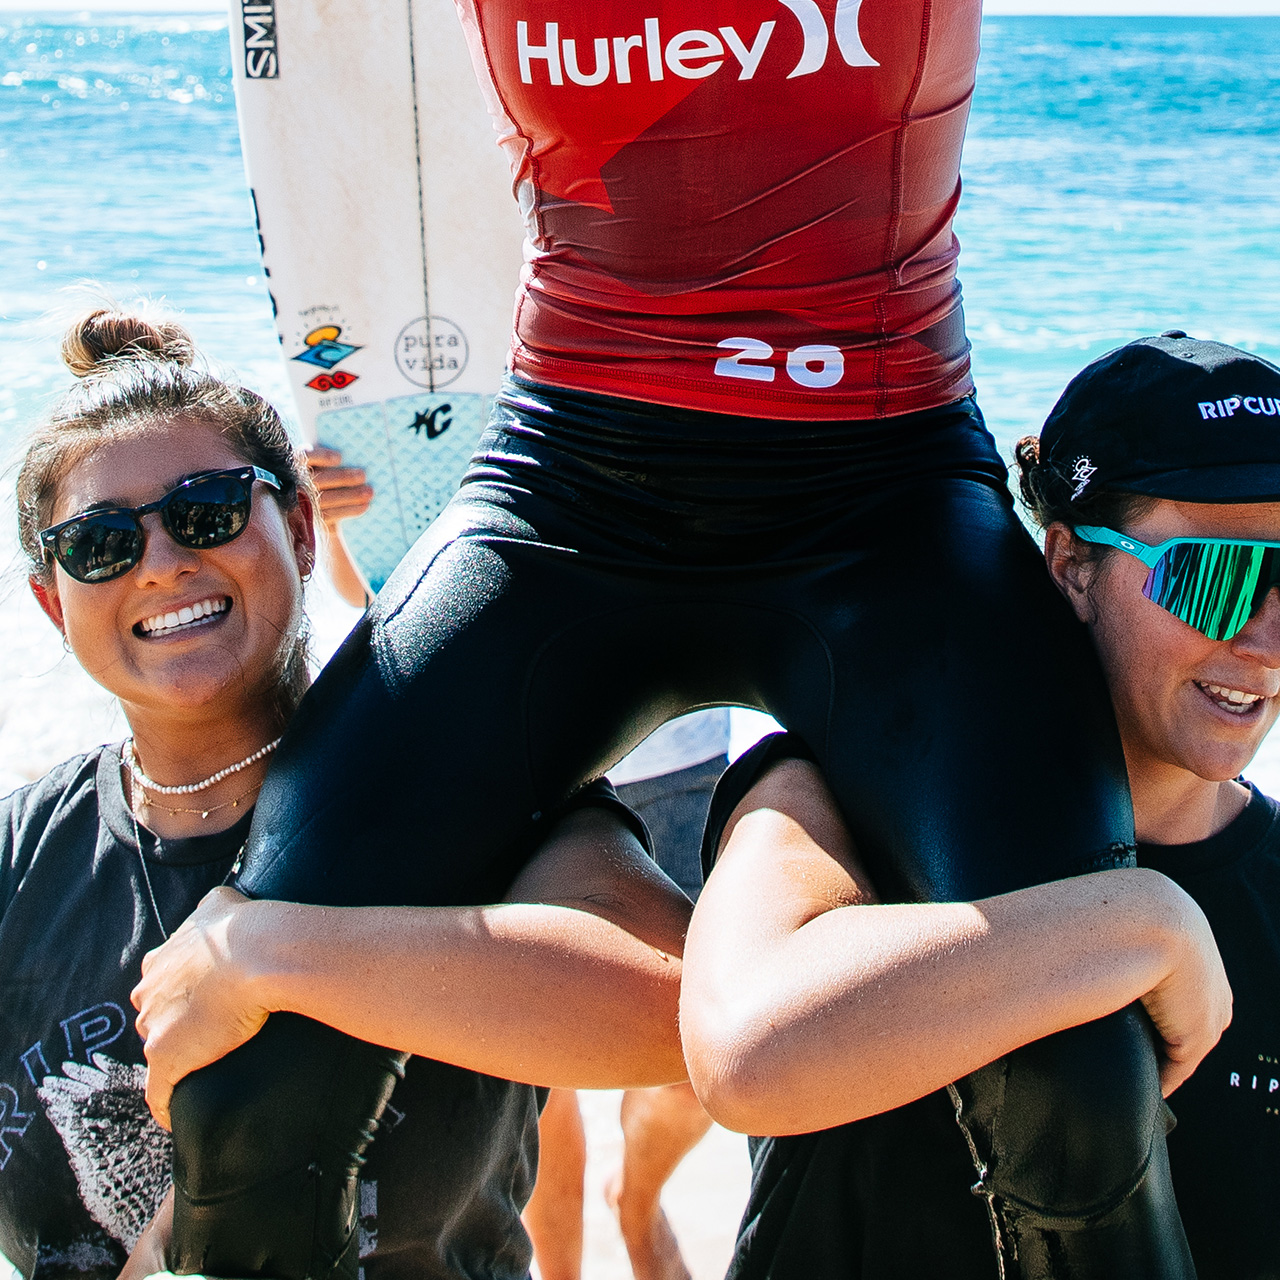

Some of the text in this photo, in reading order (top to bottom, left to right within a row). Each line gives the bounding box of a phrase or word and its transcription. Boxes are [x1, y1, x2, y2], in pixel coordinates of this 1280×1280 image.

[517, 17, 777, 86] Hurley
[404, 334, 459, 352] pura
[404, 354, 459, 371] vida
[714, 336, 845, 388] 20
